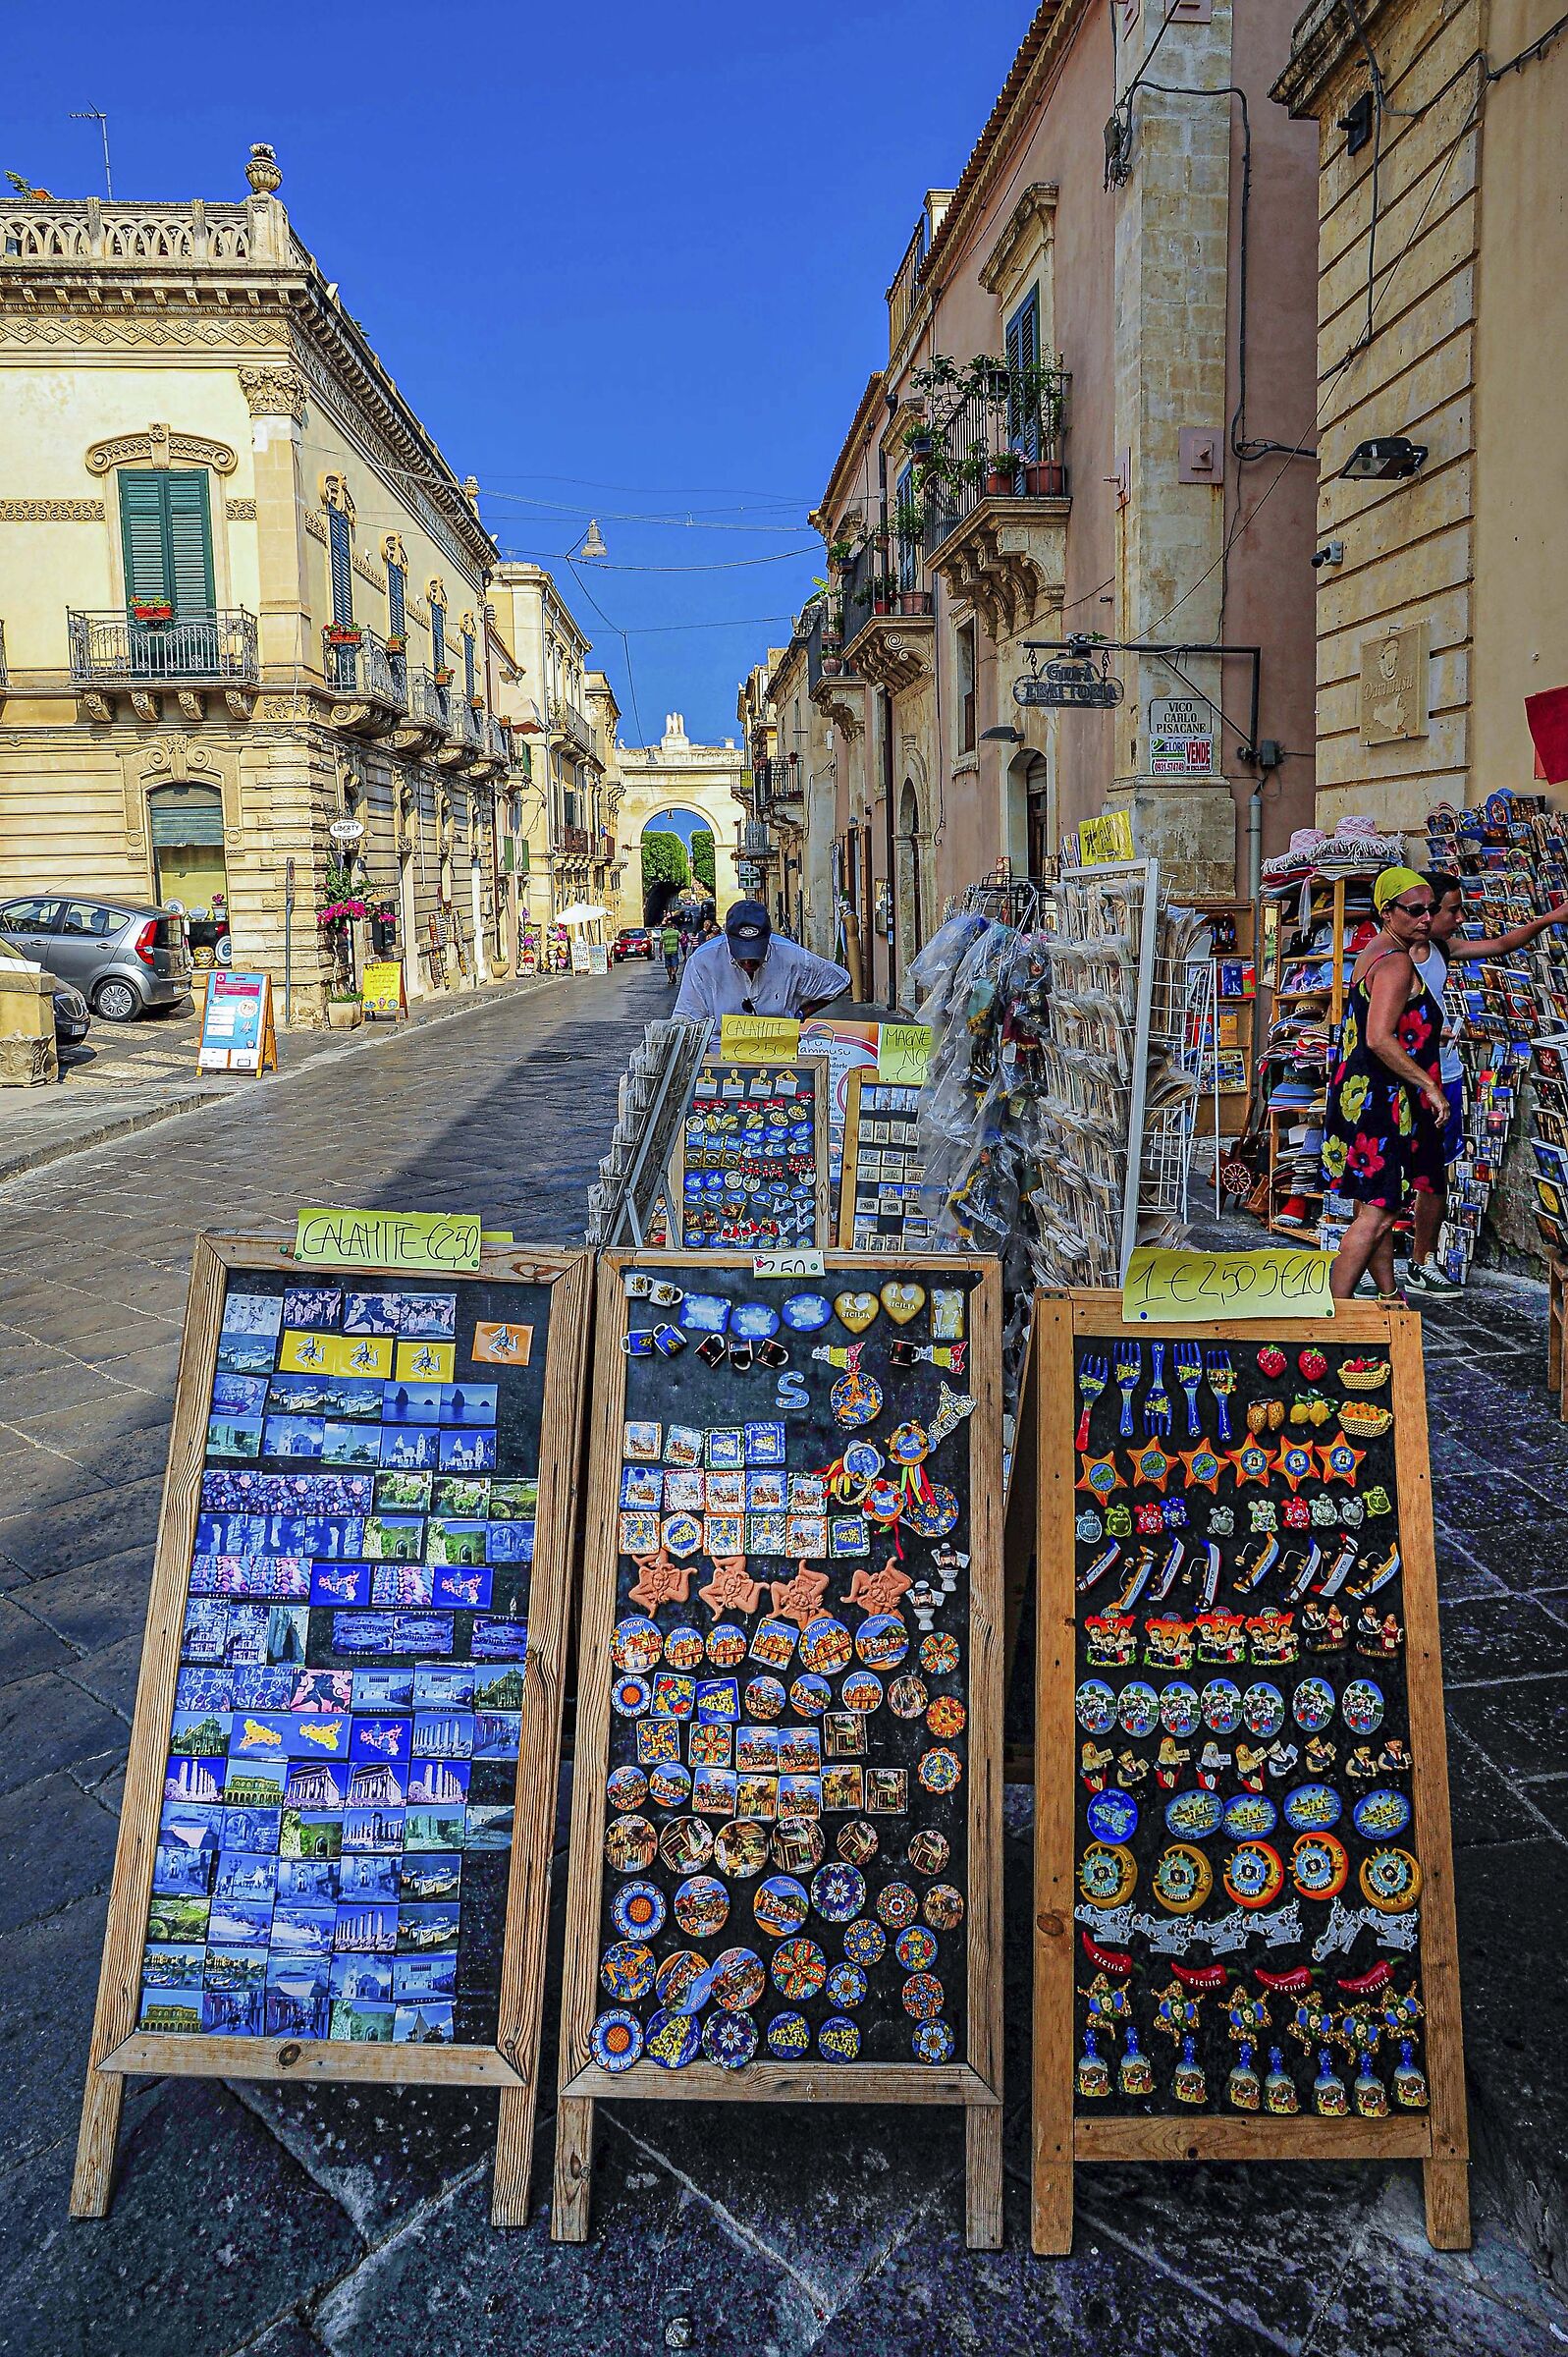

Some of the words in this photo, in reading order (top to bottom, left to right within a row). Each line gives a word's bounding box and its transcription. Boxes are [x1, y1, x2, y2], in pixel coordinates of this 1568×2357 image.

[1168, 702, 1193, 713] VICO
[1164, 713, 1197, 723] CARLO
[1157, 723, 1206, 733] PISACANE
[1186, 741, 1211, 764] VENDE
[726, 1019, 792, 1037] CALAMITE
[799, 1047, 850, 1056] ammusu
[302, 1218, 426, 1263] CALAMITE
[886, 1300, 916, 1310] SICILIA
[1093, 1561, 1108, 1577] NOTO
[1336, 1561, 1347, 1579] NOTO
[1377, 1569, 1392, 1585] NOTO
